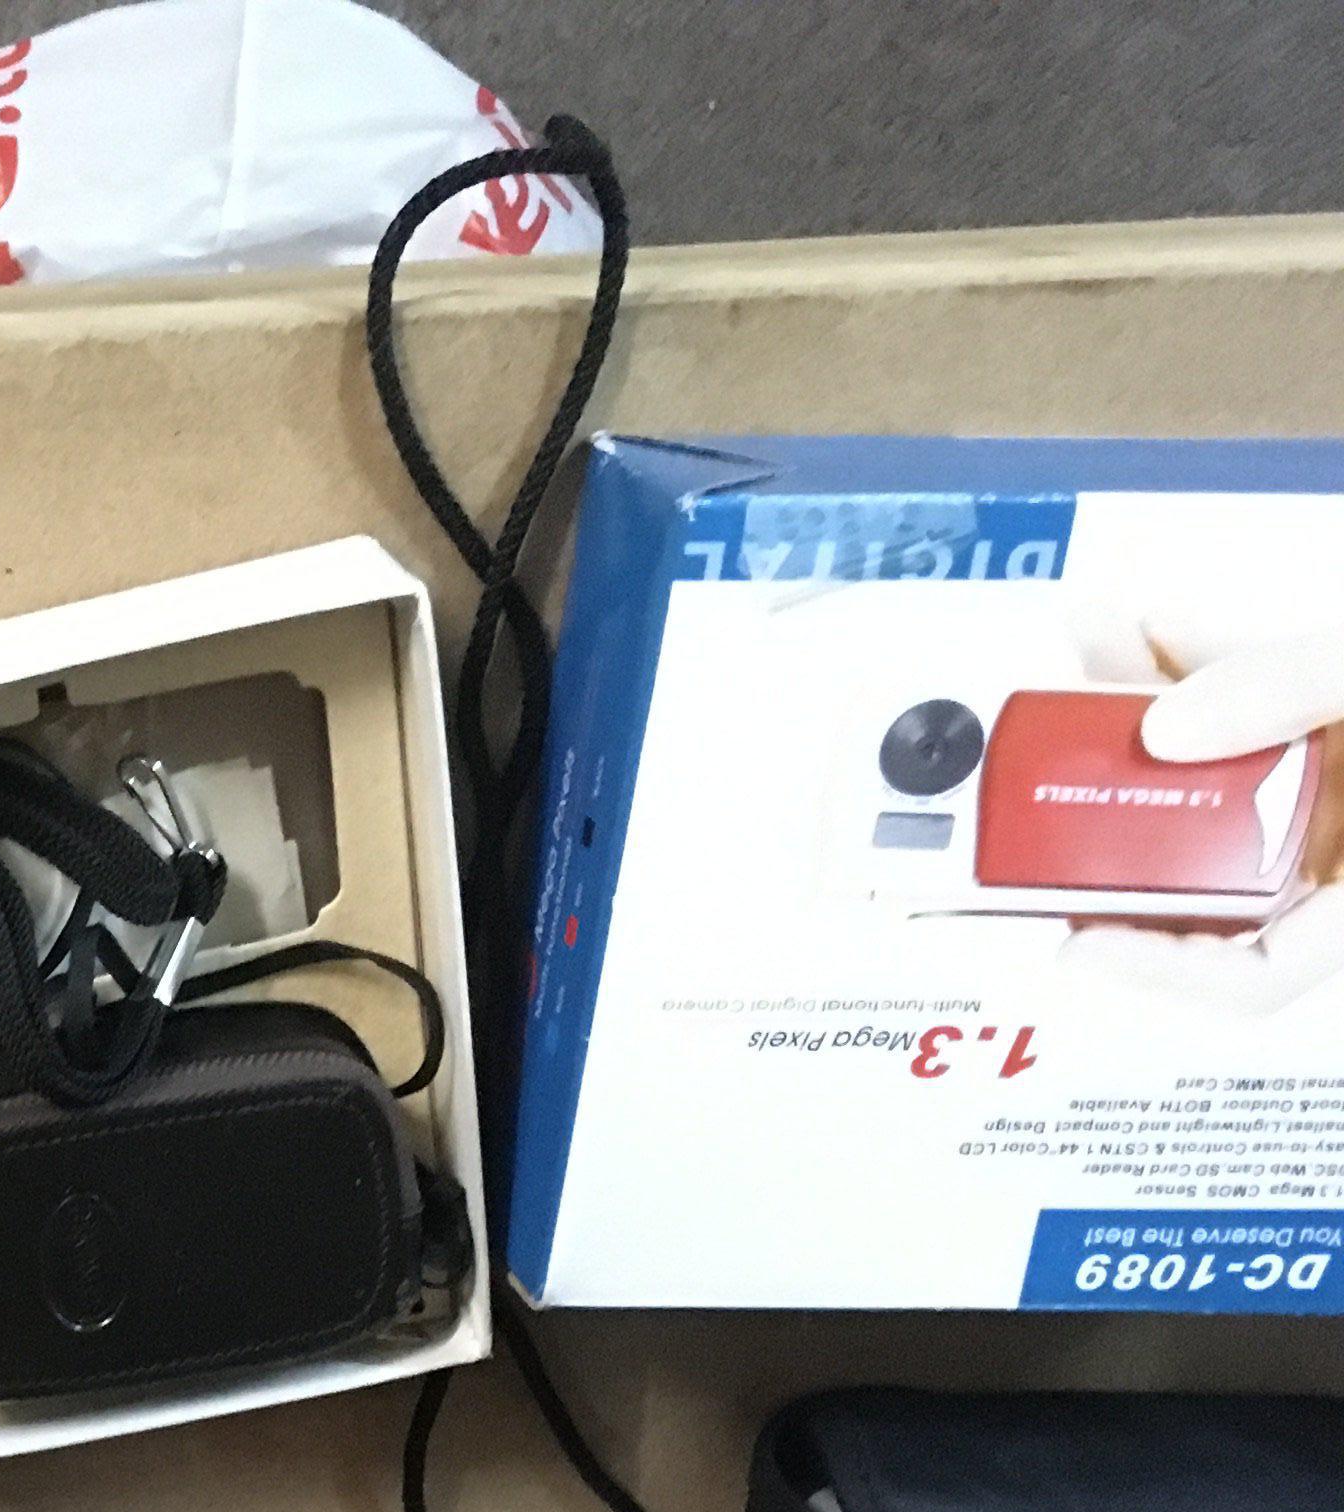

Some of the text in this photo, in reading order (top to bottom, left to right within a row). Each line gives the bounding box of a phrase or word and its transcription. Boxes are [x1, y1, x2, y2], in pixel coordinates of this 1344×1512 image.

[1034, 784, 1112, 805] PIXELS
[1118, 788, 1184, 806] MEGA
[662, 997, 982, 1013] Multi-functional Digital Camera
[748, 1025, 1038, 1079] 1.3 Mega Pixels
[1176, 1077, 1218, 1091] Card
[1223, 1077, 1296, 1091] SD/MMC
[1069, 1099, 1151, 1113] Available
[1160, 1099, 1211, 1113] BOTH
[1222, 1099, 1293, 1113] Outdoor
[984, 1118, 1046, 1134] Design
[1055, 1119, 1134, 1134] Compact
[1139, 1120, 1170, 1134] and
[1176, 1118, 1281, 1134] Lightweight
[959, 1142, 996, 1156] LCD
[1100, 1142, 1150, 1156] CSTN
[1156, 1142, 1166, 1155] &
[1172, 1141, 1247, 1155] Controls
[1082, 1163, 1145, 1177] Reader
[1149, 1163, 1191, 1177] Card
[1196, 1163, 1221, 1177] SD
[1270, 1163, 1306, 1177] Web
[1134, 1184, 1197, 1198] Sensor
[1207, 1184, 1261, 1198] CMOS
[1269, 1182, 1316, 1198] Mega
[1083, 1227, 1343, 1248] You Deserve The Best
[1074, 1253, 1332, 1292] DC-1089
